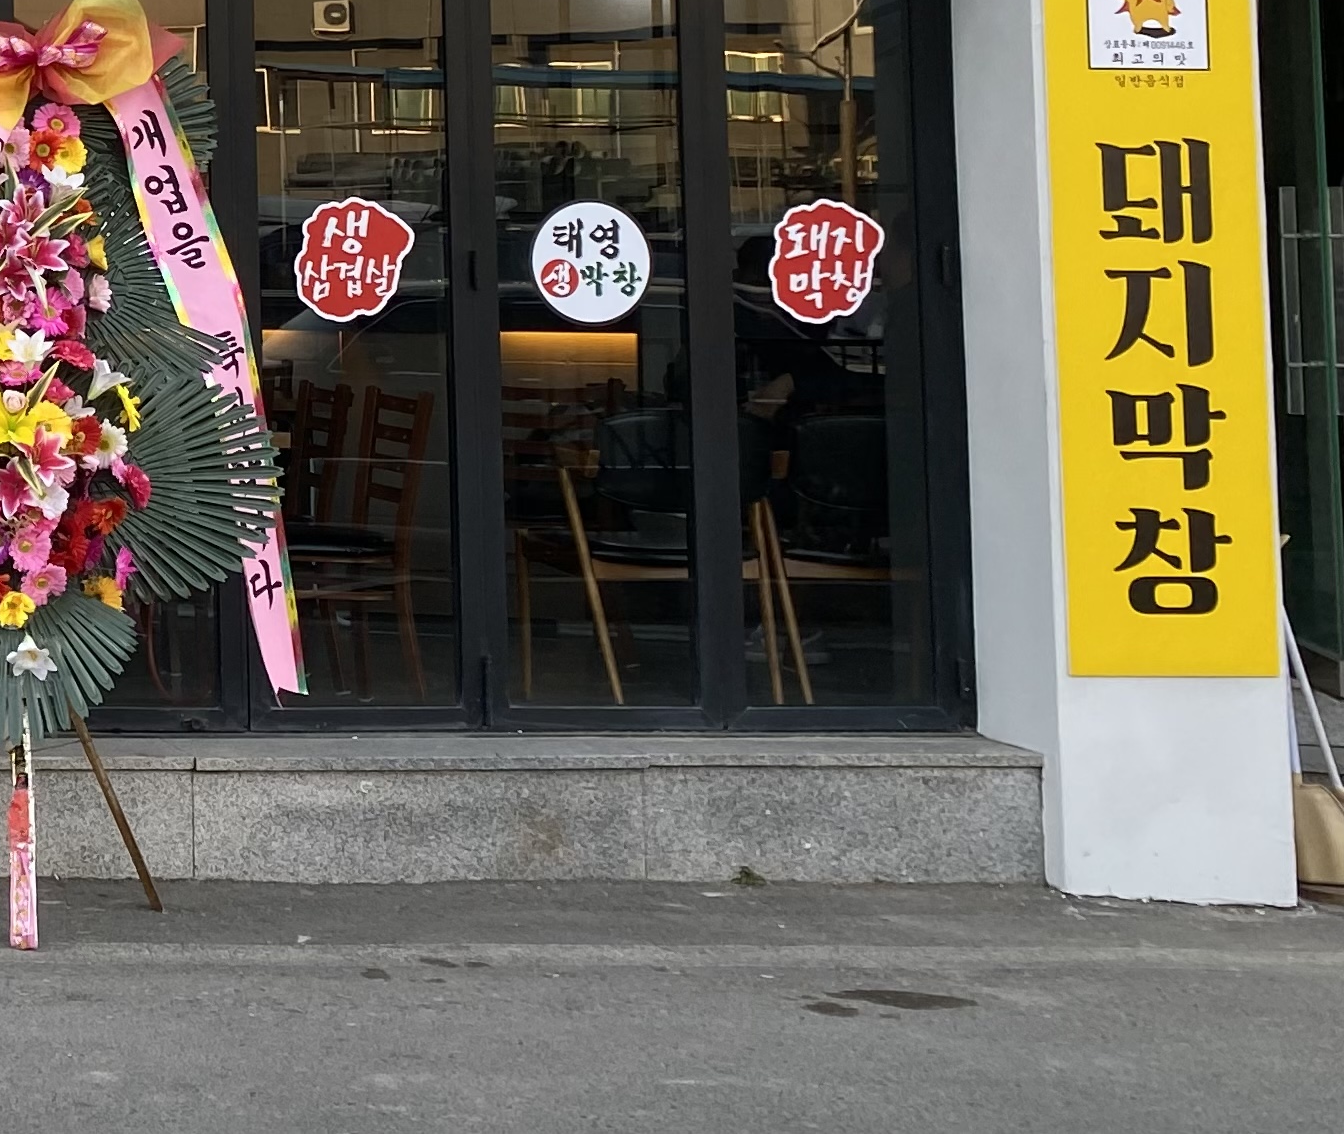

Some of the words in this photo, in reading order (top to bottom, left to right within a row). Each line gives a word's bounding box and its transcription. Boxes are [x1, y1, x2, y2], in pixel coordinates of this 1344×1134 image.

[131, 109, 210, 270] 개업을
[321, 209, 370, 255] 생
[552, 217, 621, 260] 태영
[784, 221, 865, 260] 돼지
[303, 254, 396, 302] 삼겹살
[542, 261, 572, 297] 생
[579, 261, 643, 298] 막창
[789, 260, 869, 310] 막창
[1095, 137, 1233, 616] 돼지막창
